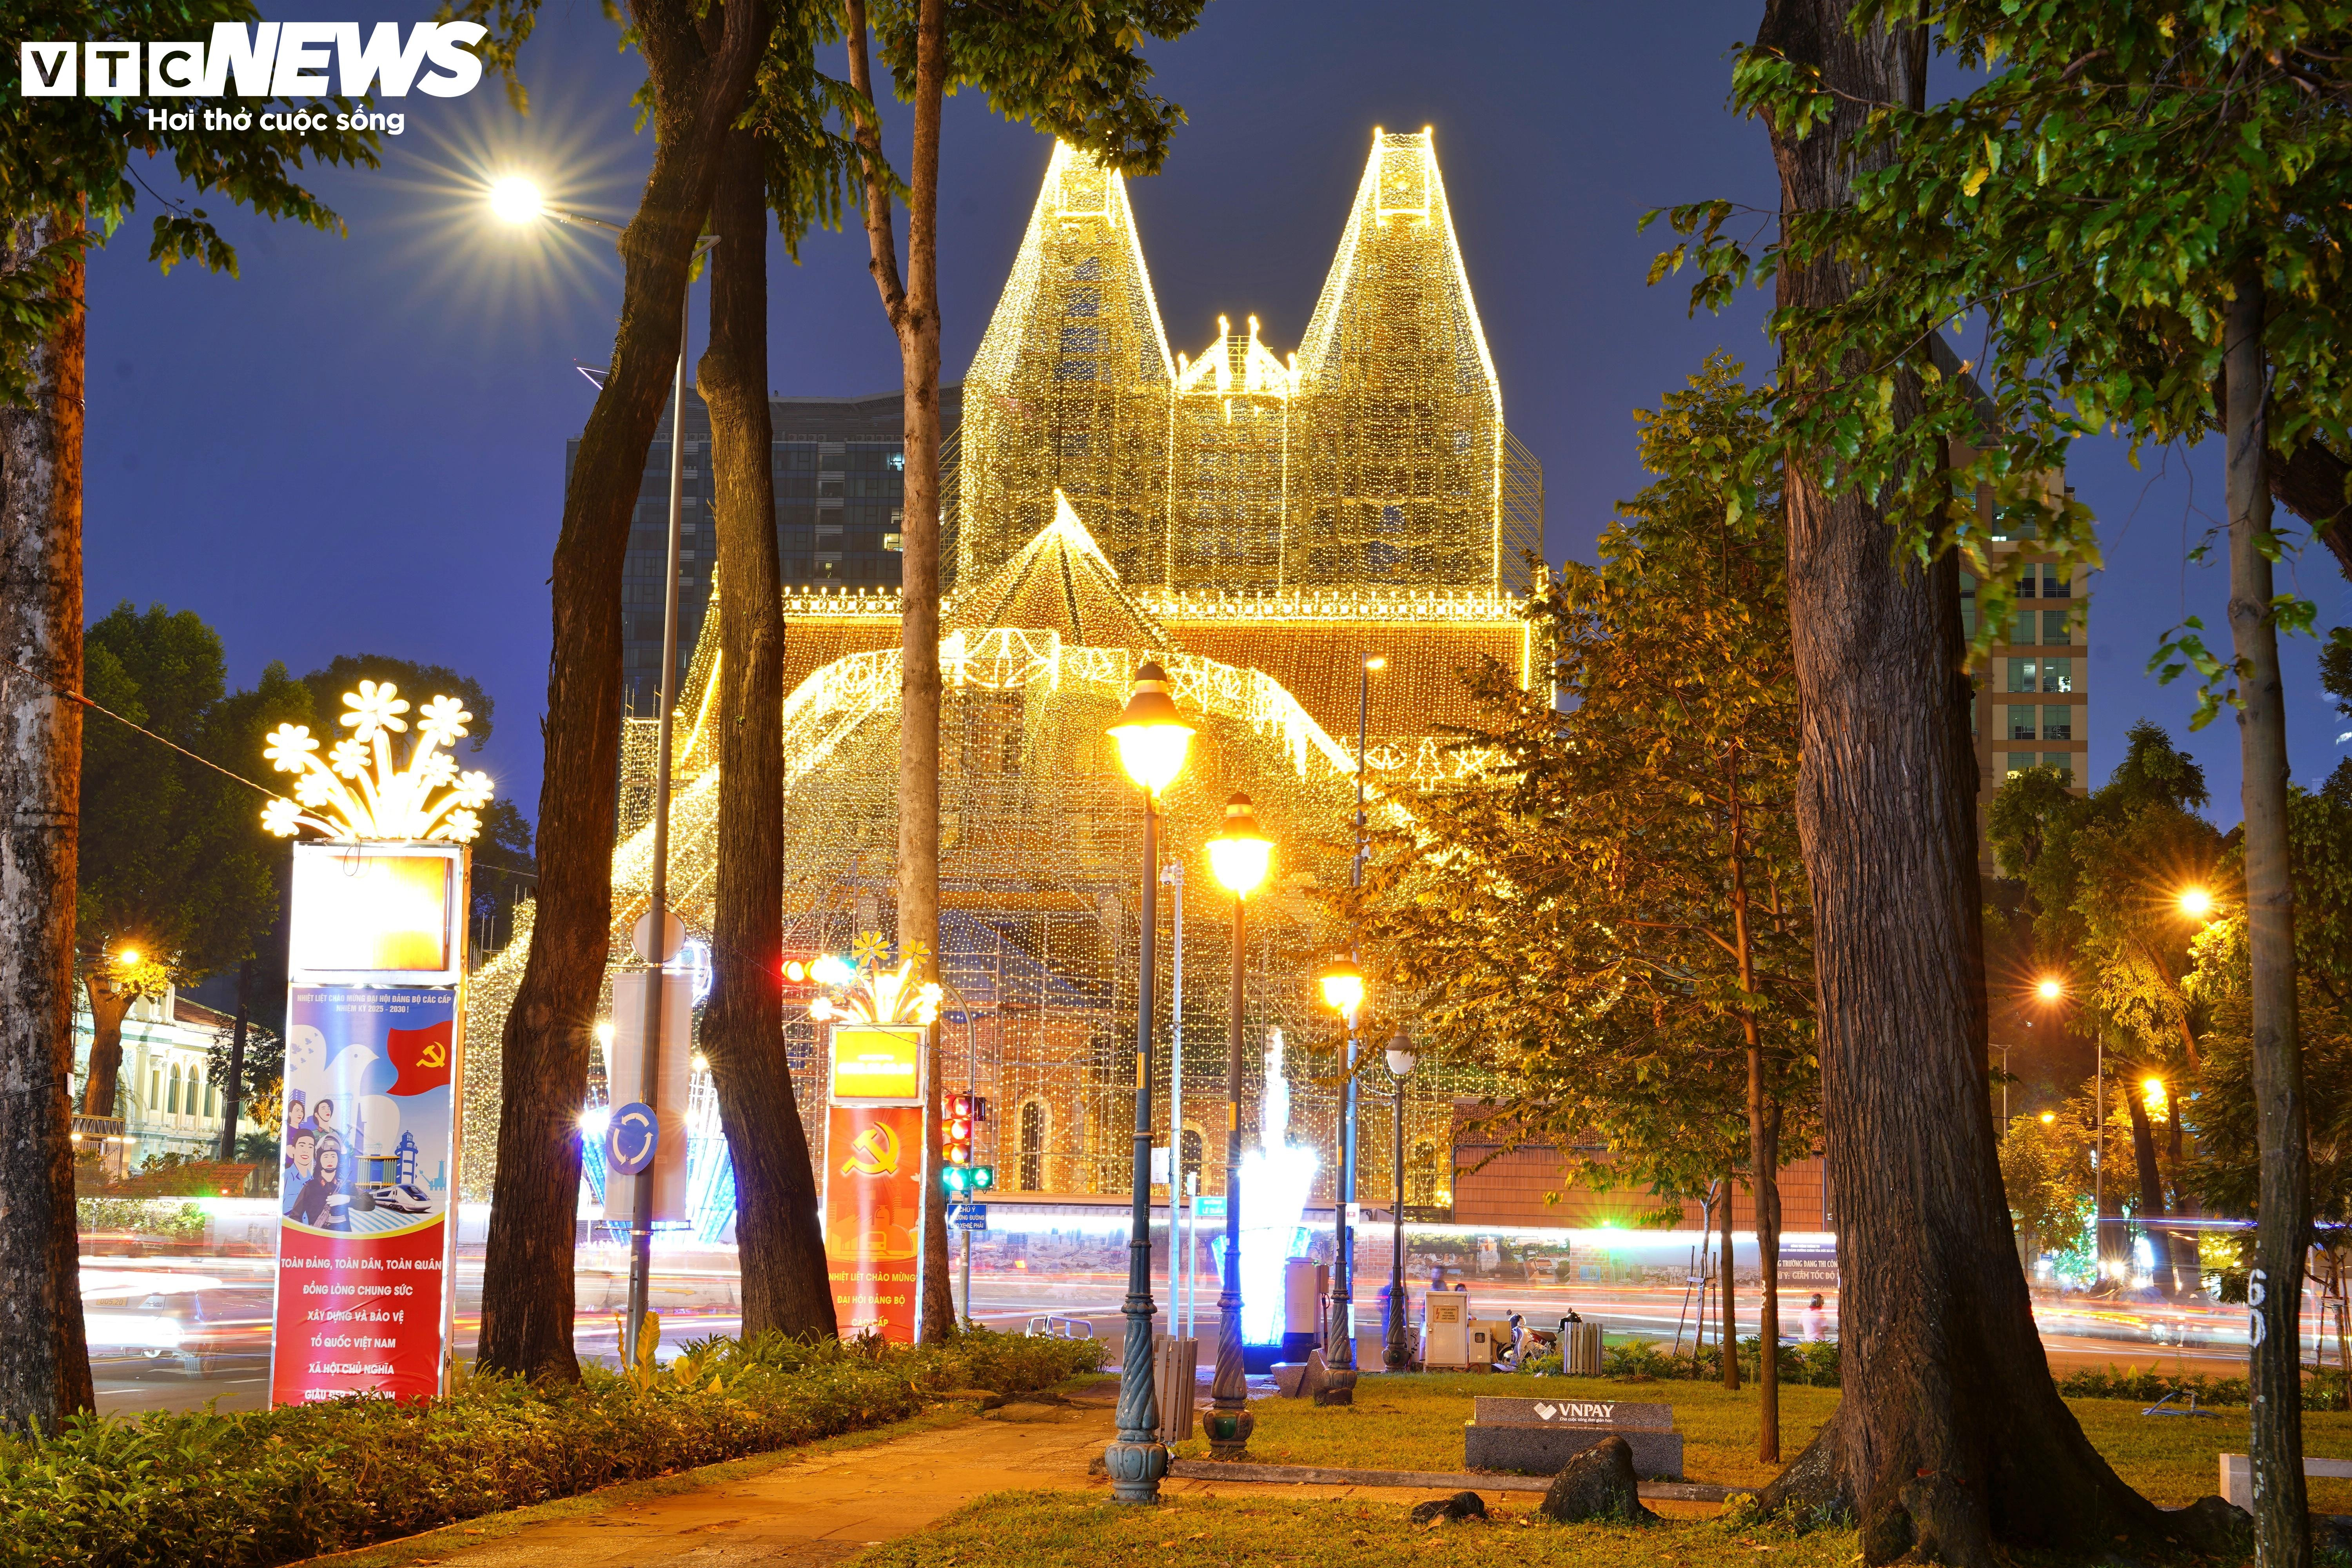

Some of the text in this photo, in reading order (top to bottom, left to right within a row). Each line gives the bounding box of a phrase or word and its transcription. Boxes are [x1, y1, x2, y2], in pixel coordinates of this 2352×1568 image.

[297, 993, 451, 1004] NHIỆT LIỆT CHÀO MỪNG ĐẠI HỘI ĐẢNG BỘ CÁC CẤP
[336, 1004, 356, 1013] NHIỆM
[358, 1004, 367, 1012] KỲ
[281, 1255, 442, 1271] TOÀN ĐẢNG, TOÀN DÂN, TOÀN QUÂN
[1782, 1259, 1803, 1267] TRƯỜNG
[1827, 1259, 1838, 1268] CÔN
[828, 1270, 916, 1283] NHIỆT LIỆT CHÀO MỪNG
[1792, 1270, 1809, 1279] GIẢM
[1810, 1270, 1824, 1279] TỐC
[1826, 1270, 1835, 1281] ĐỘ
[303, 1280, 413, 1296] ĐỒNG LÒNG CHUNG SỨC
[837, 1293, 906, 1307] ĐẠI HỘI ĐẢNG BỘ
[307, 1308, 404, 1325] XÂY DỰNG VÀ BẢO VỆ
[851, 1315, 889, 1327] CÁC CẤP
[311, 1332, 396, 1350] TỔ QUỐC VIỆT NAM
[308, 1361, 395, 1376] XÃ HỘI CHỦ NGHĨA
[305, 1387, 327, 1400] GIÀU
[1559, 1403, 1614, 1417] VNPAY
